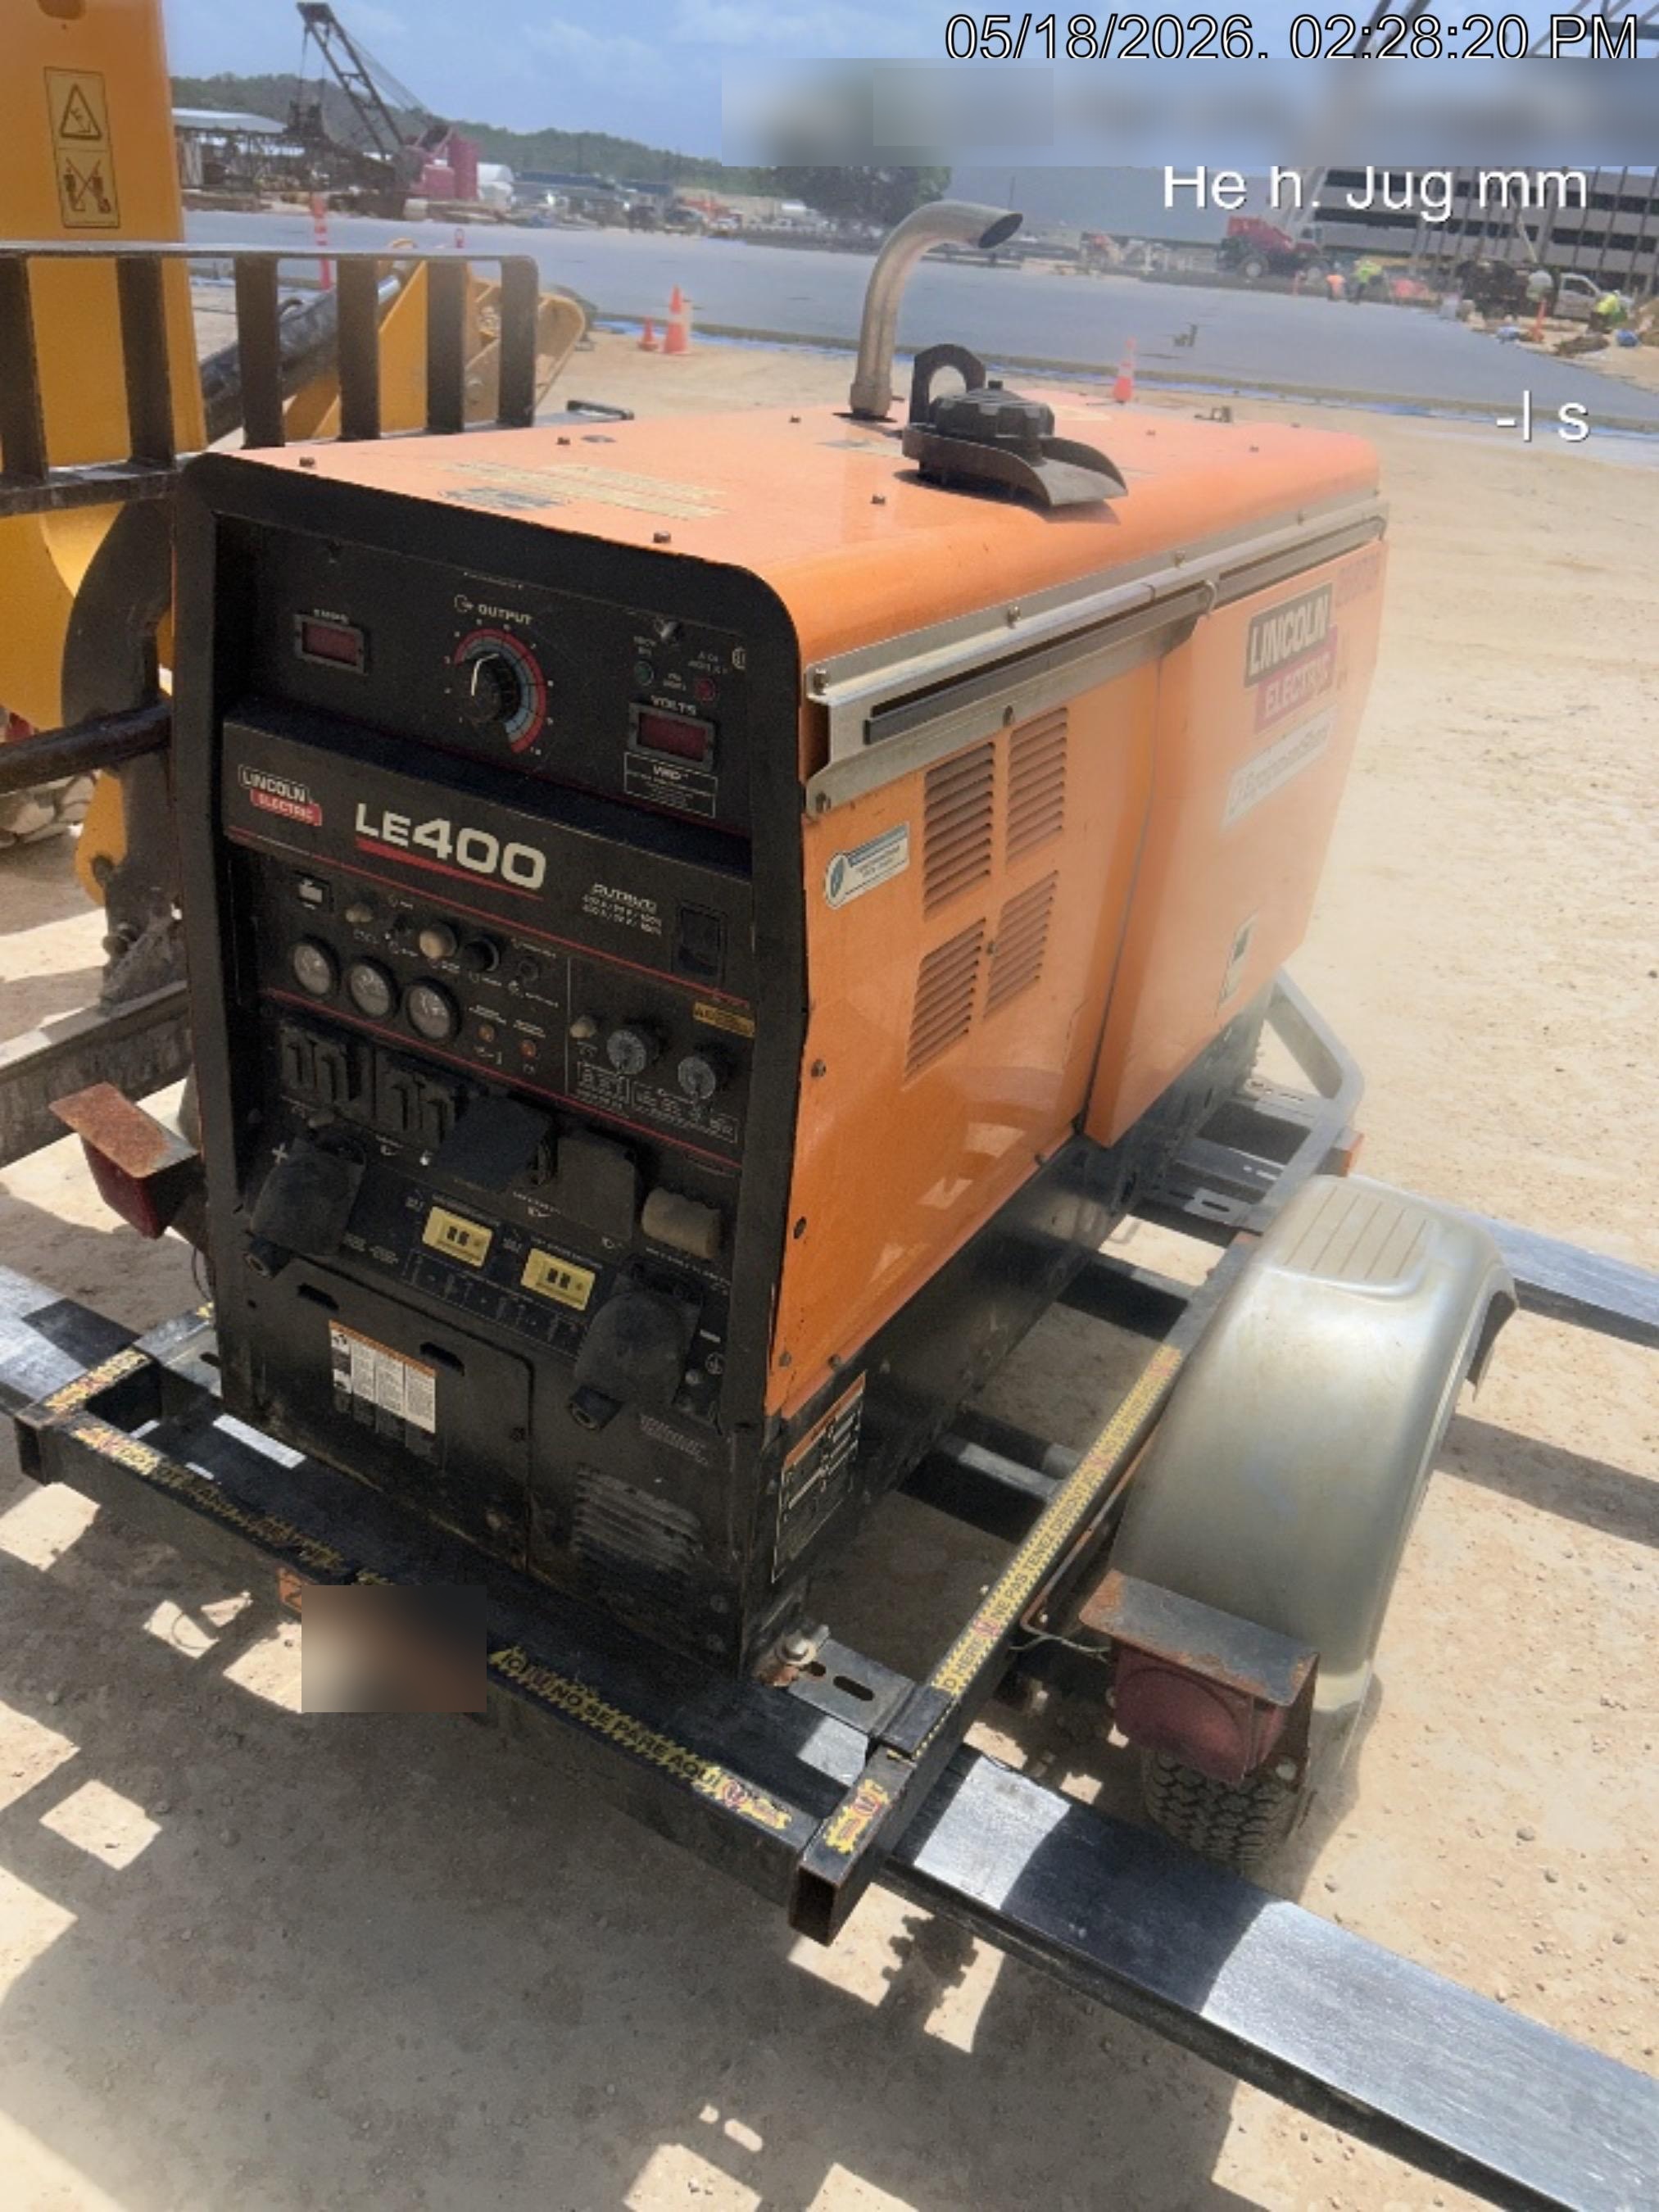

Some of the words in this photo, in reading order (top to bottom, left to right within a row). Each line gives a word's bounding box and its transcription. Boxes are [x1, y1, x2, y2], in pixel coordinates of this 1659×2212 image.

[477, 602, 533, 625] OUTPUT
[1249, 592, 1330, 678] LINCOLN
[242, 769, 307, 803] LINCOLN
[356, 802, 547, 890] LE400
[549, 1684, 584, 1708] NO
